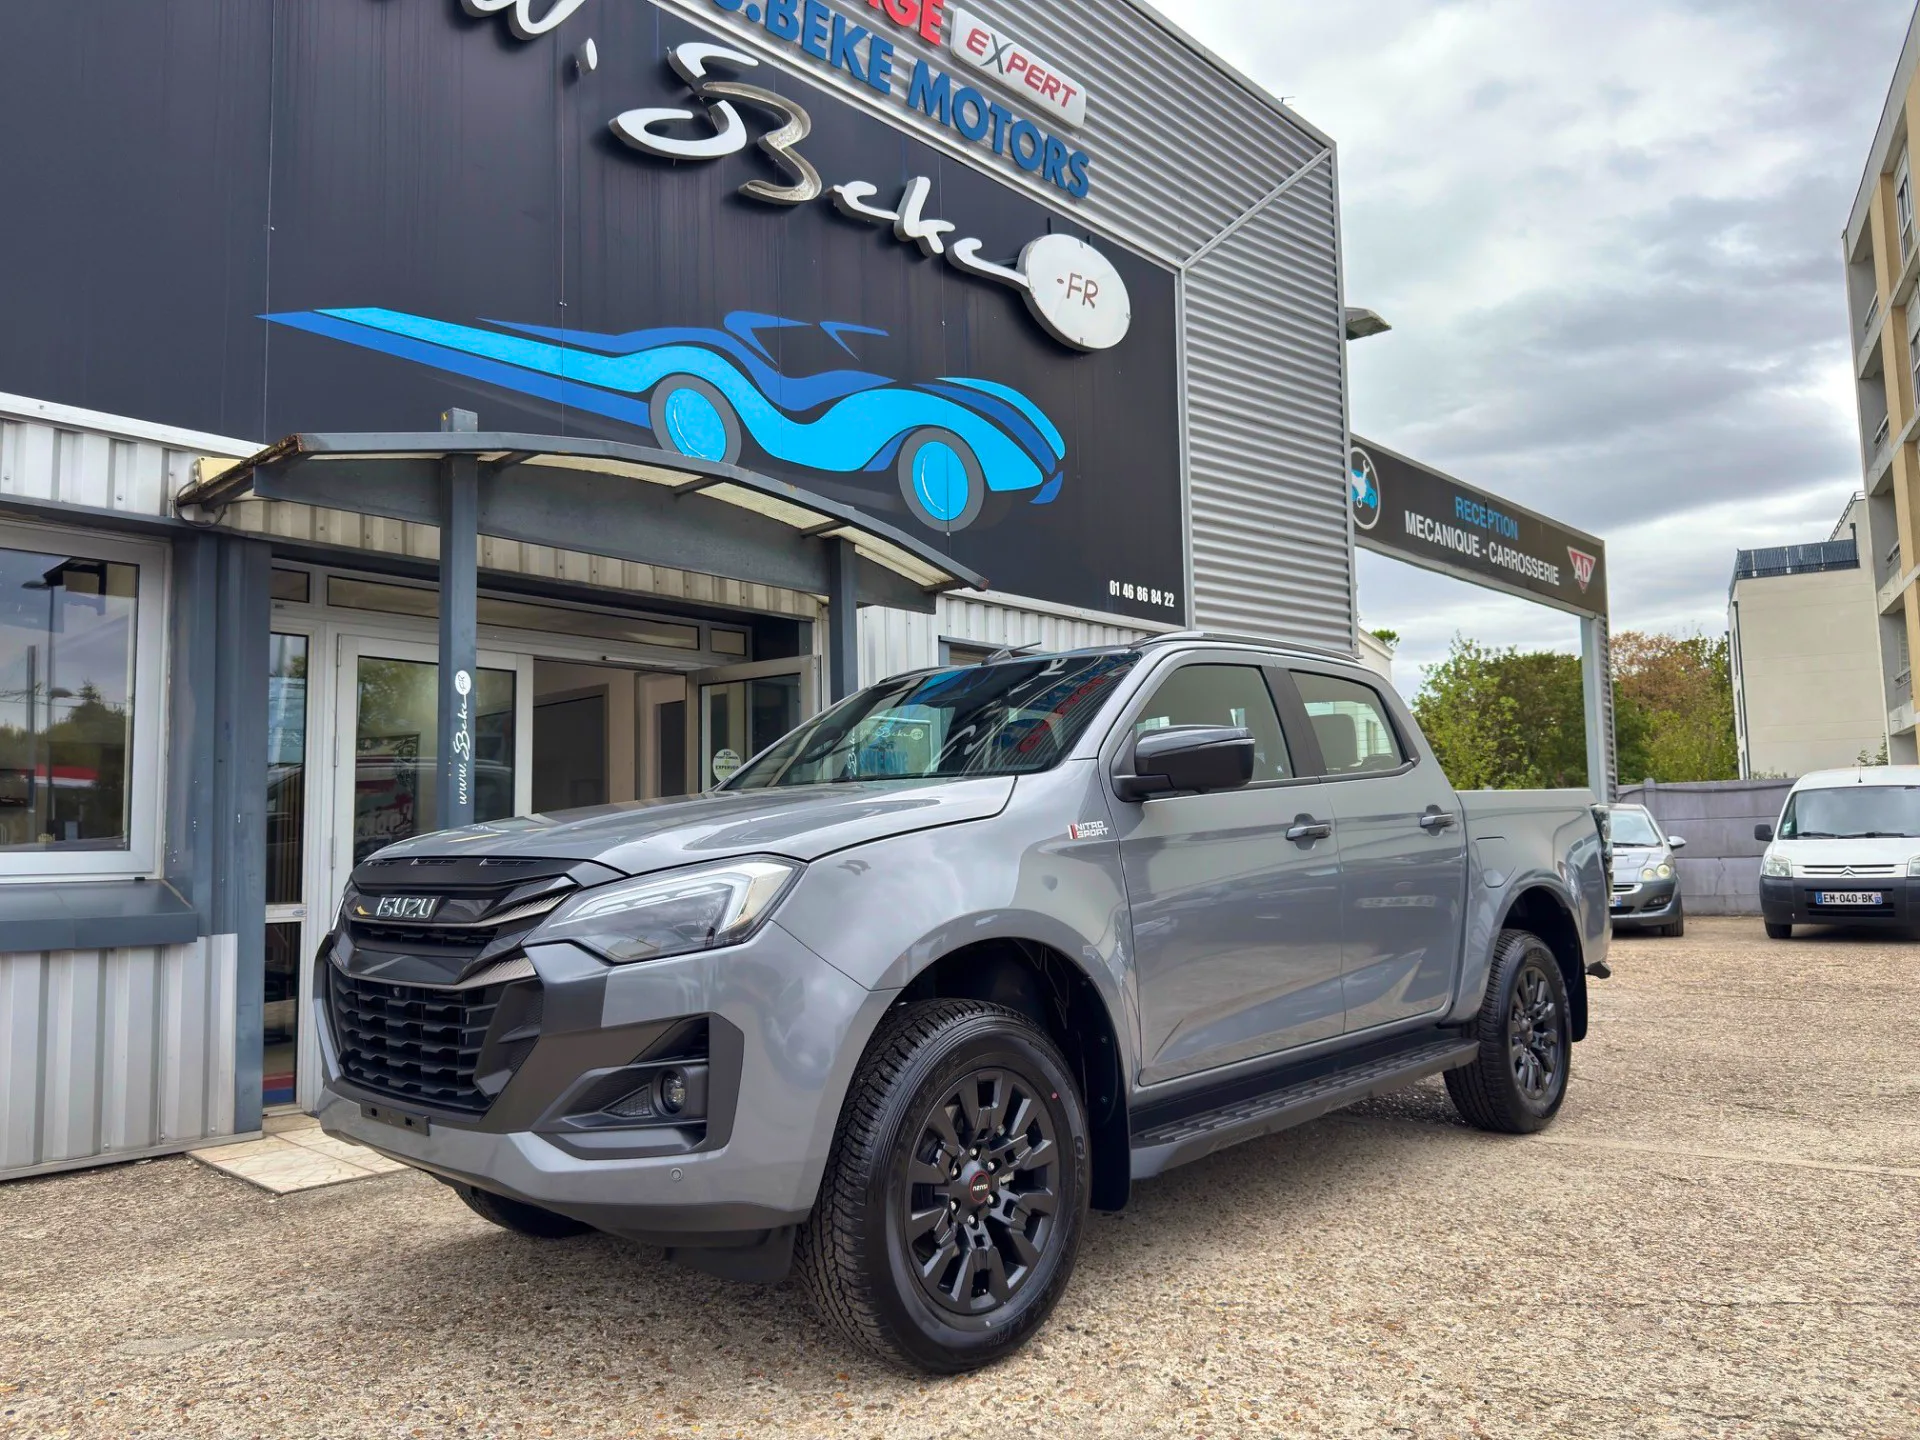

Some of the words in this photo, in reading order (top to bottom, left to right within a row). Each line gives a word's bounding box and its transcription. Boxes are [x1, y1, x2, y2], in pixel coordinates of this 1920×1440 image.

[966, 27, 1077, 108] EXPERT
[907, 58, 1091, 199] MOTORS
[1454, 496, 1519, 541] RECEPTION
[1404, 510, 1481, 559] MECANIQUE
[1488, 541, 1561, 587] CARROSSERIE
[1573, 555, 1593, 585] AD
[1109, 580, 1120, 596] 01
[1122, 583, 1134, 599] 46
[1136, 586, 1149, 602] 86
[1150, 588, 1162, 605] 84
[1164, 591, 1175, 608] 22
[1074, 820, 1104, 831] NITRO
[1076, 827, 1109, 839] SPORT
[376, 897, 436, 919] ISUZU
